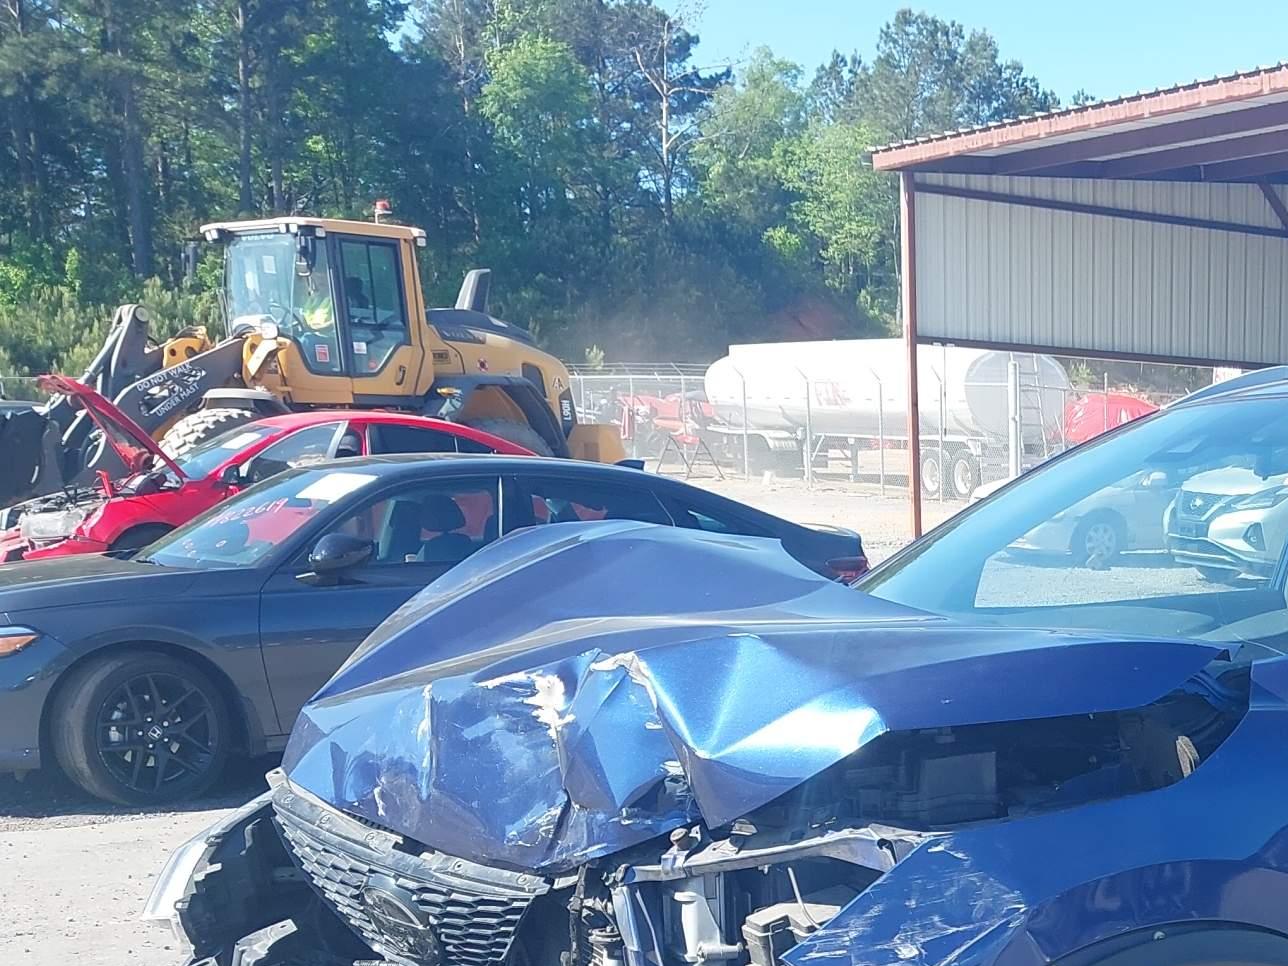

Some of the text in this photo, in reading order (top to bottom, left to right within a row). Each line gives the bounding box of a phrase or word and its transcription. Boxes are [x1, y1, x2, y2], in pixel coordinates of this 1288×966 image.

[136, 361, 192, 392] DO NOT WALK
[155, 382, 201, 417] UNDER MAST
